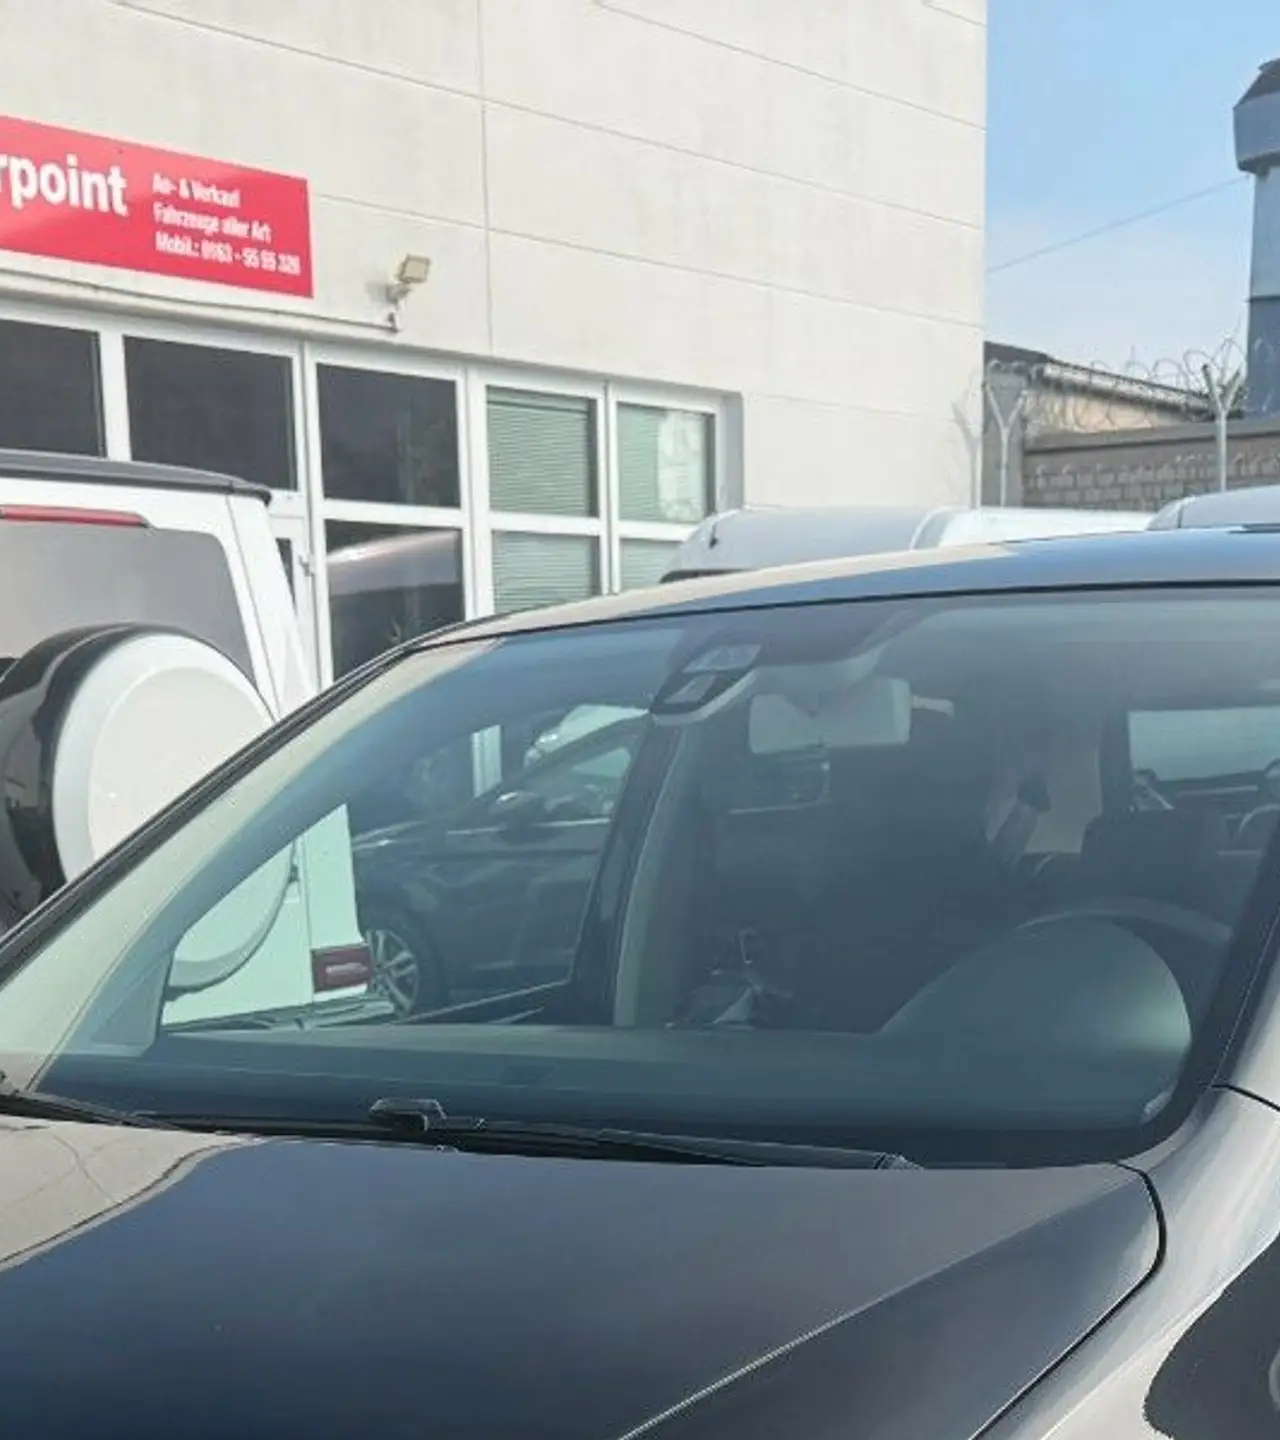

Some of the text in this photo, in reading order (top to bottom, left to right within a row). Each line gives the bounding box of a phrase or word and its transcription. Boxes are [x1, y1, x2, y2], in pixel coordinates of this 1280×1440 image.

[191, 180, 240, 208] Verkauf
[152, 201, 272, 243] Fahrzeuge aller Art
